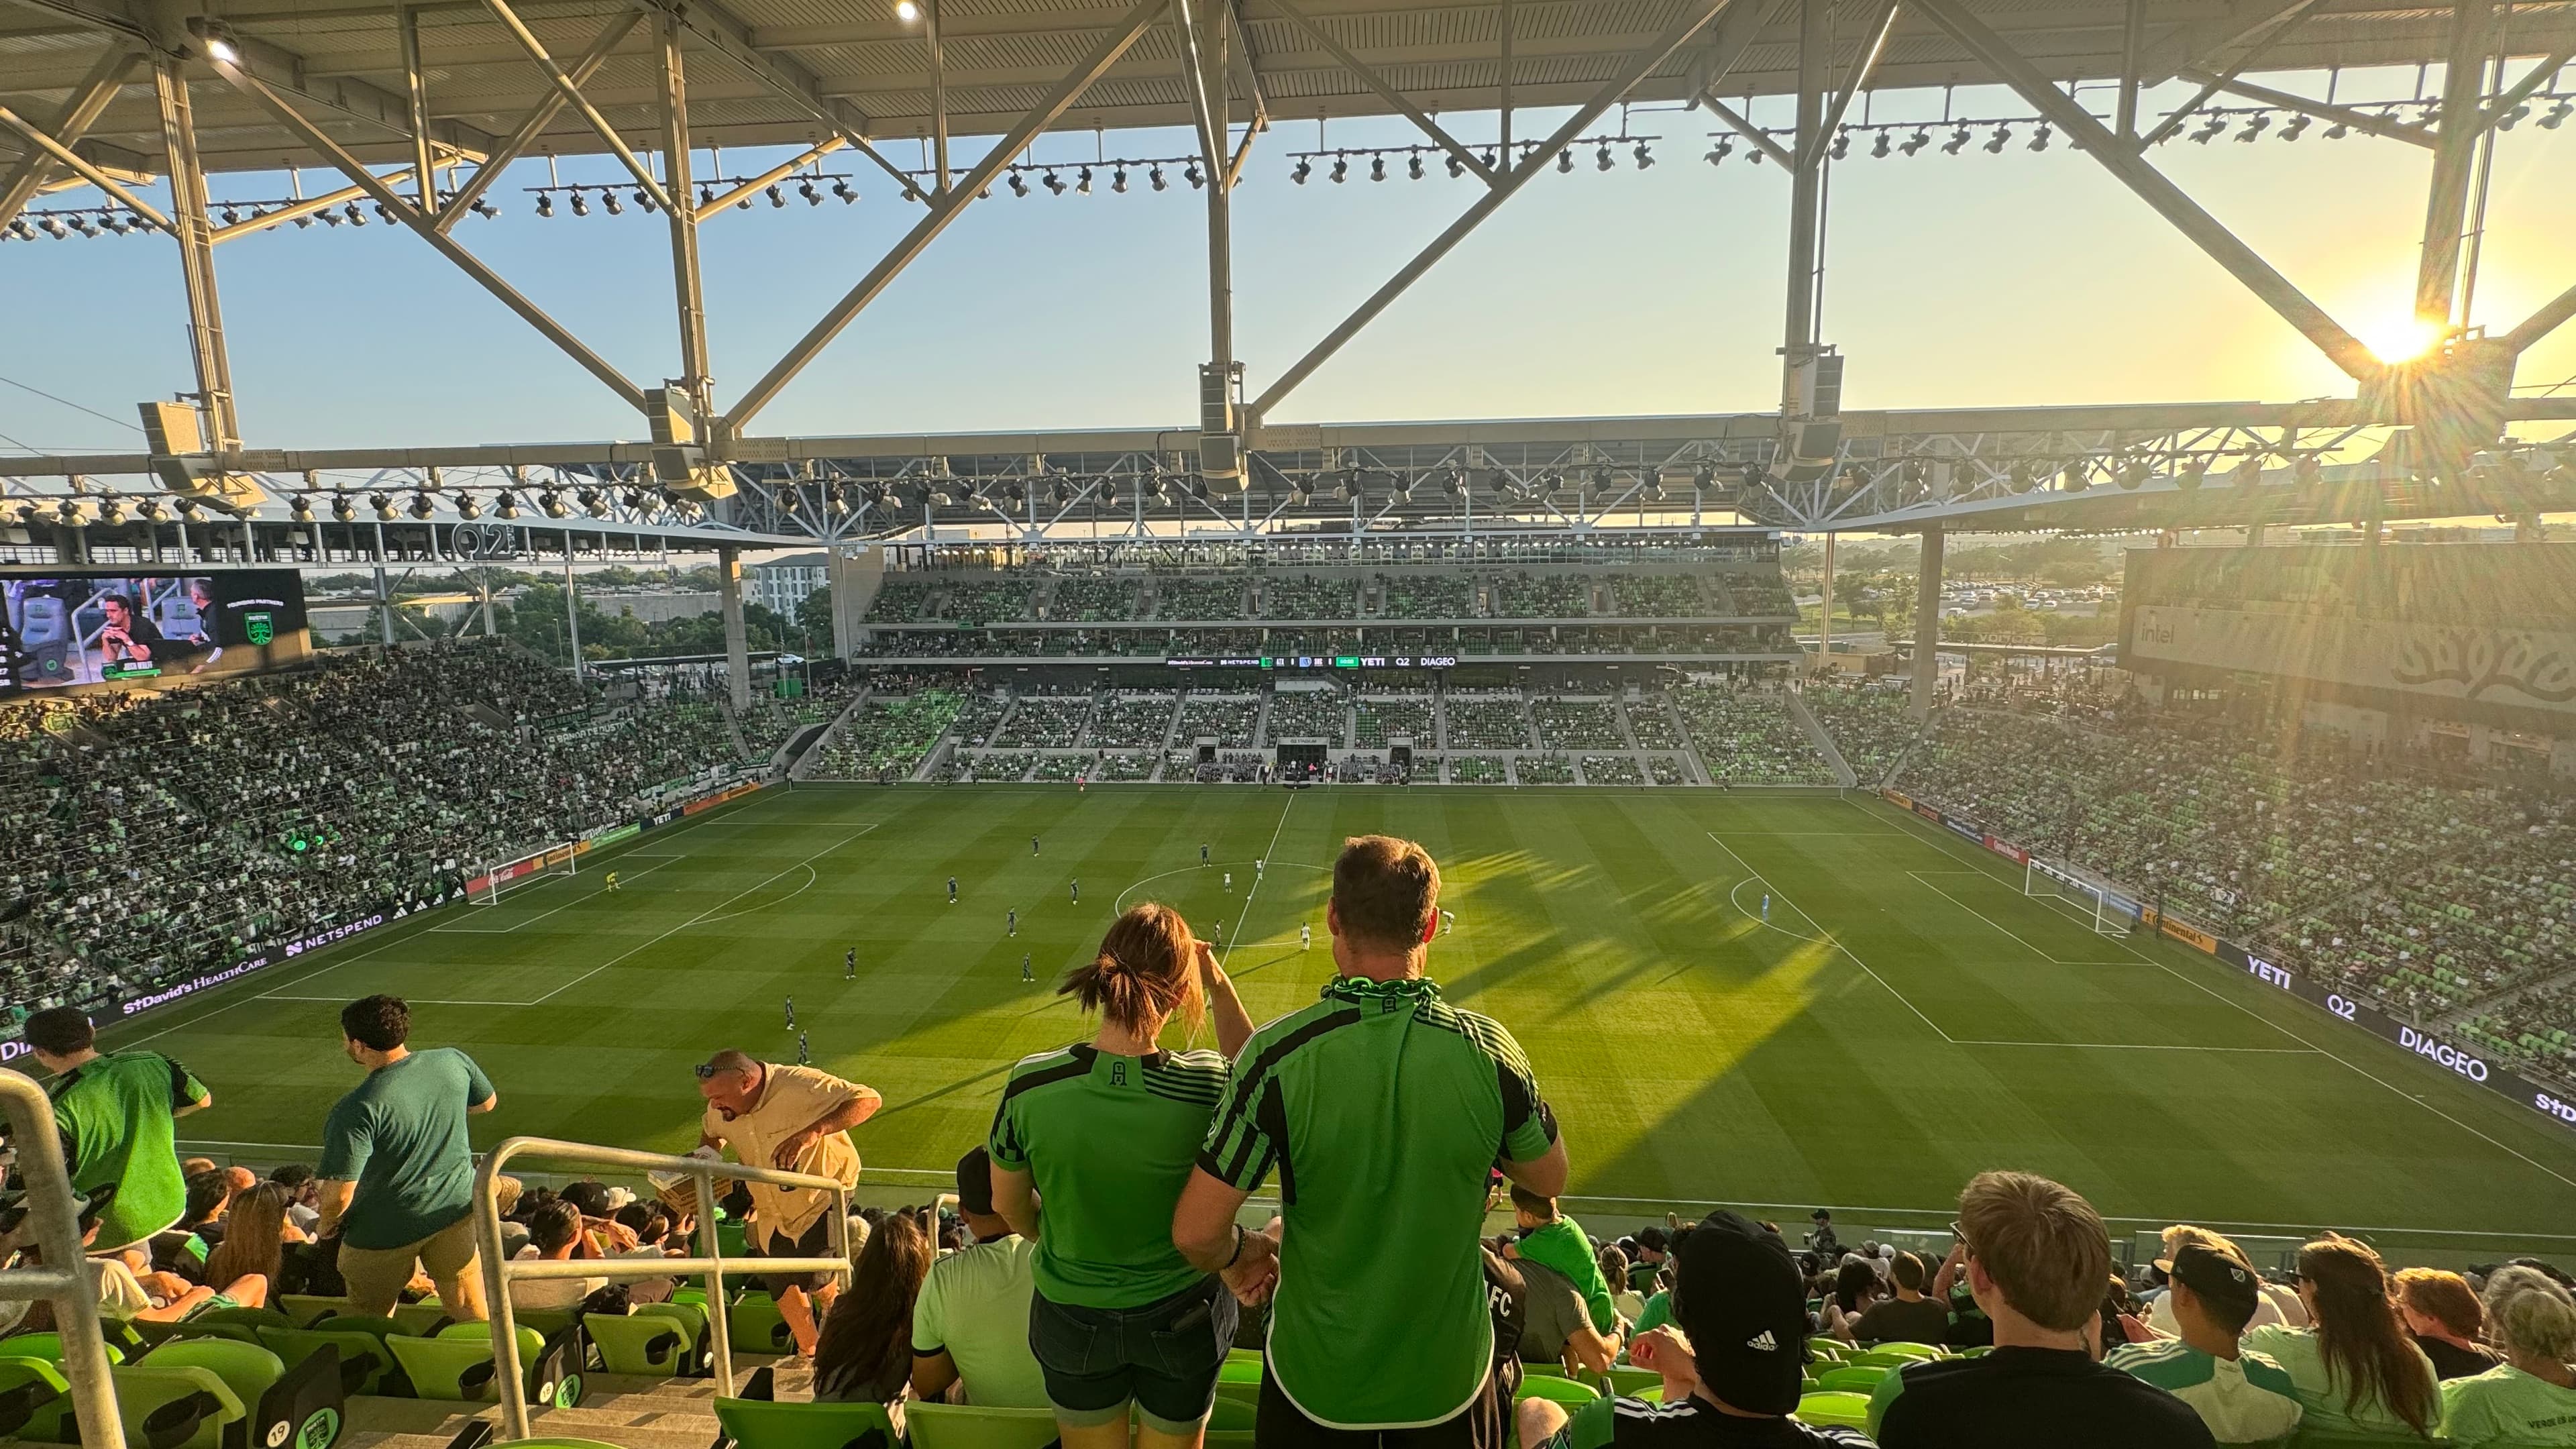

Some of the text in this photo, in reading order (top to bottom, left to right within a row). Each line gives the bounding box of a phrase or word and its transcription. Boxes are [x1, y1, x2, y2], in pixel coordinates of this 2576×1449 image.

[451, 522, 511, 561] Q2
[2141, 623, 2174, 644] intel
[1360, 657, 1455, 666] YETI Q2 DIAGEO
[653, 812, 671, 826] YETI
[306, 914, 382, 949] NETSPEND
[2153, 914, 2196, 941] Cntinental
[2247, 955, 2292, 989] YETI
[2327, 994, 2356, 1021] Q2
[2400, 1026, 2487, 1081] DIAGEO
[271, 1425, 285, 1442] 19
